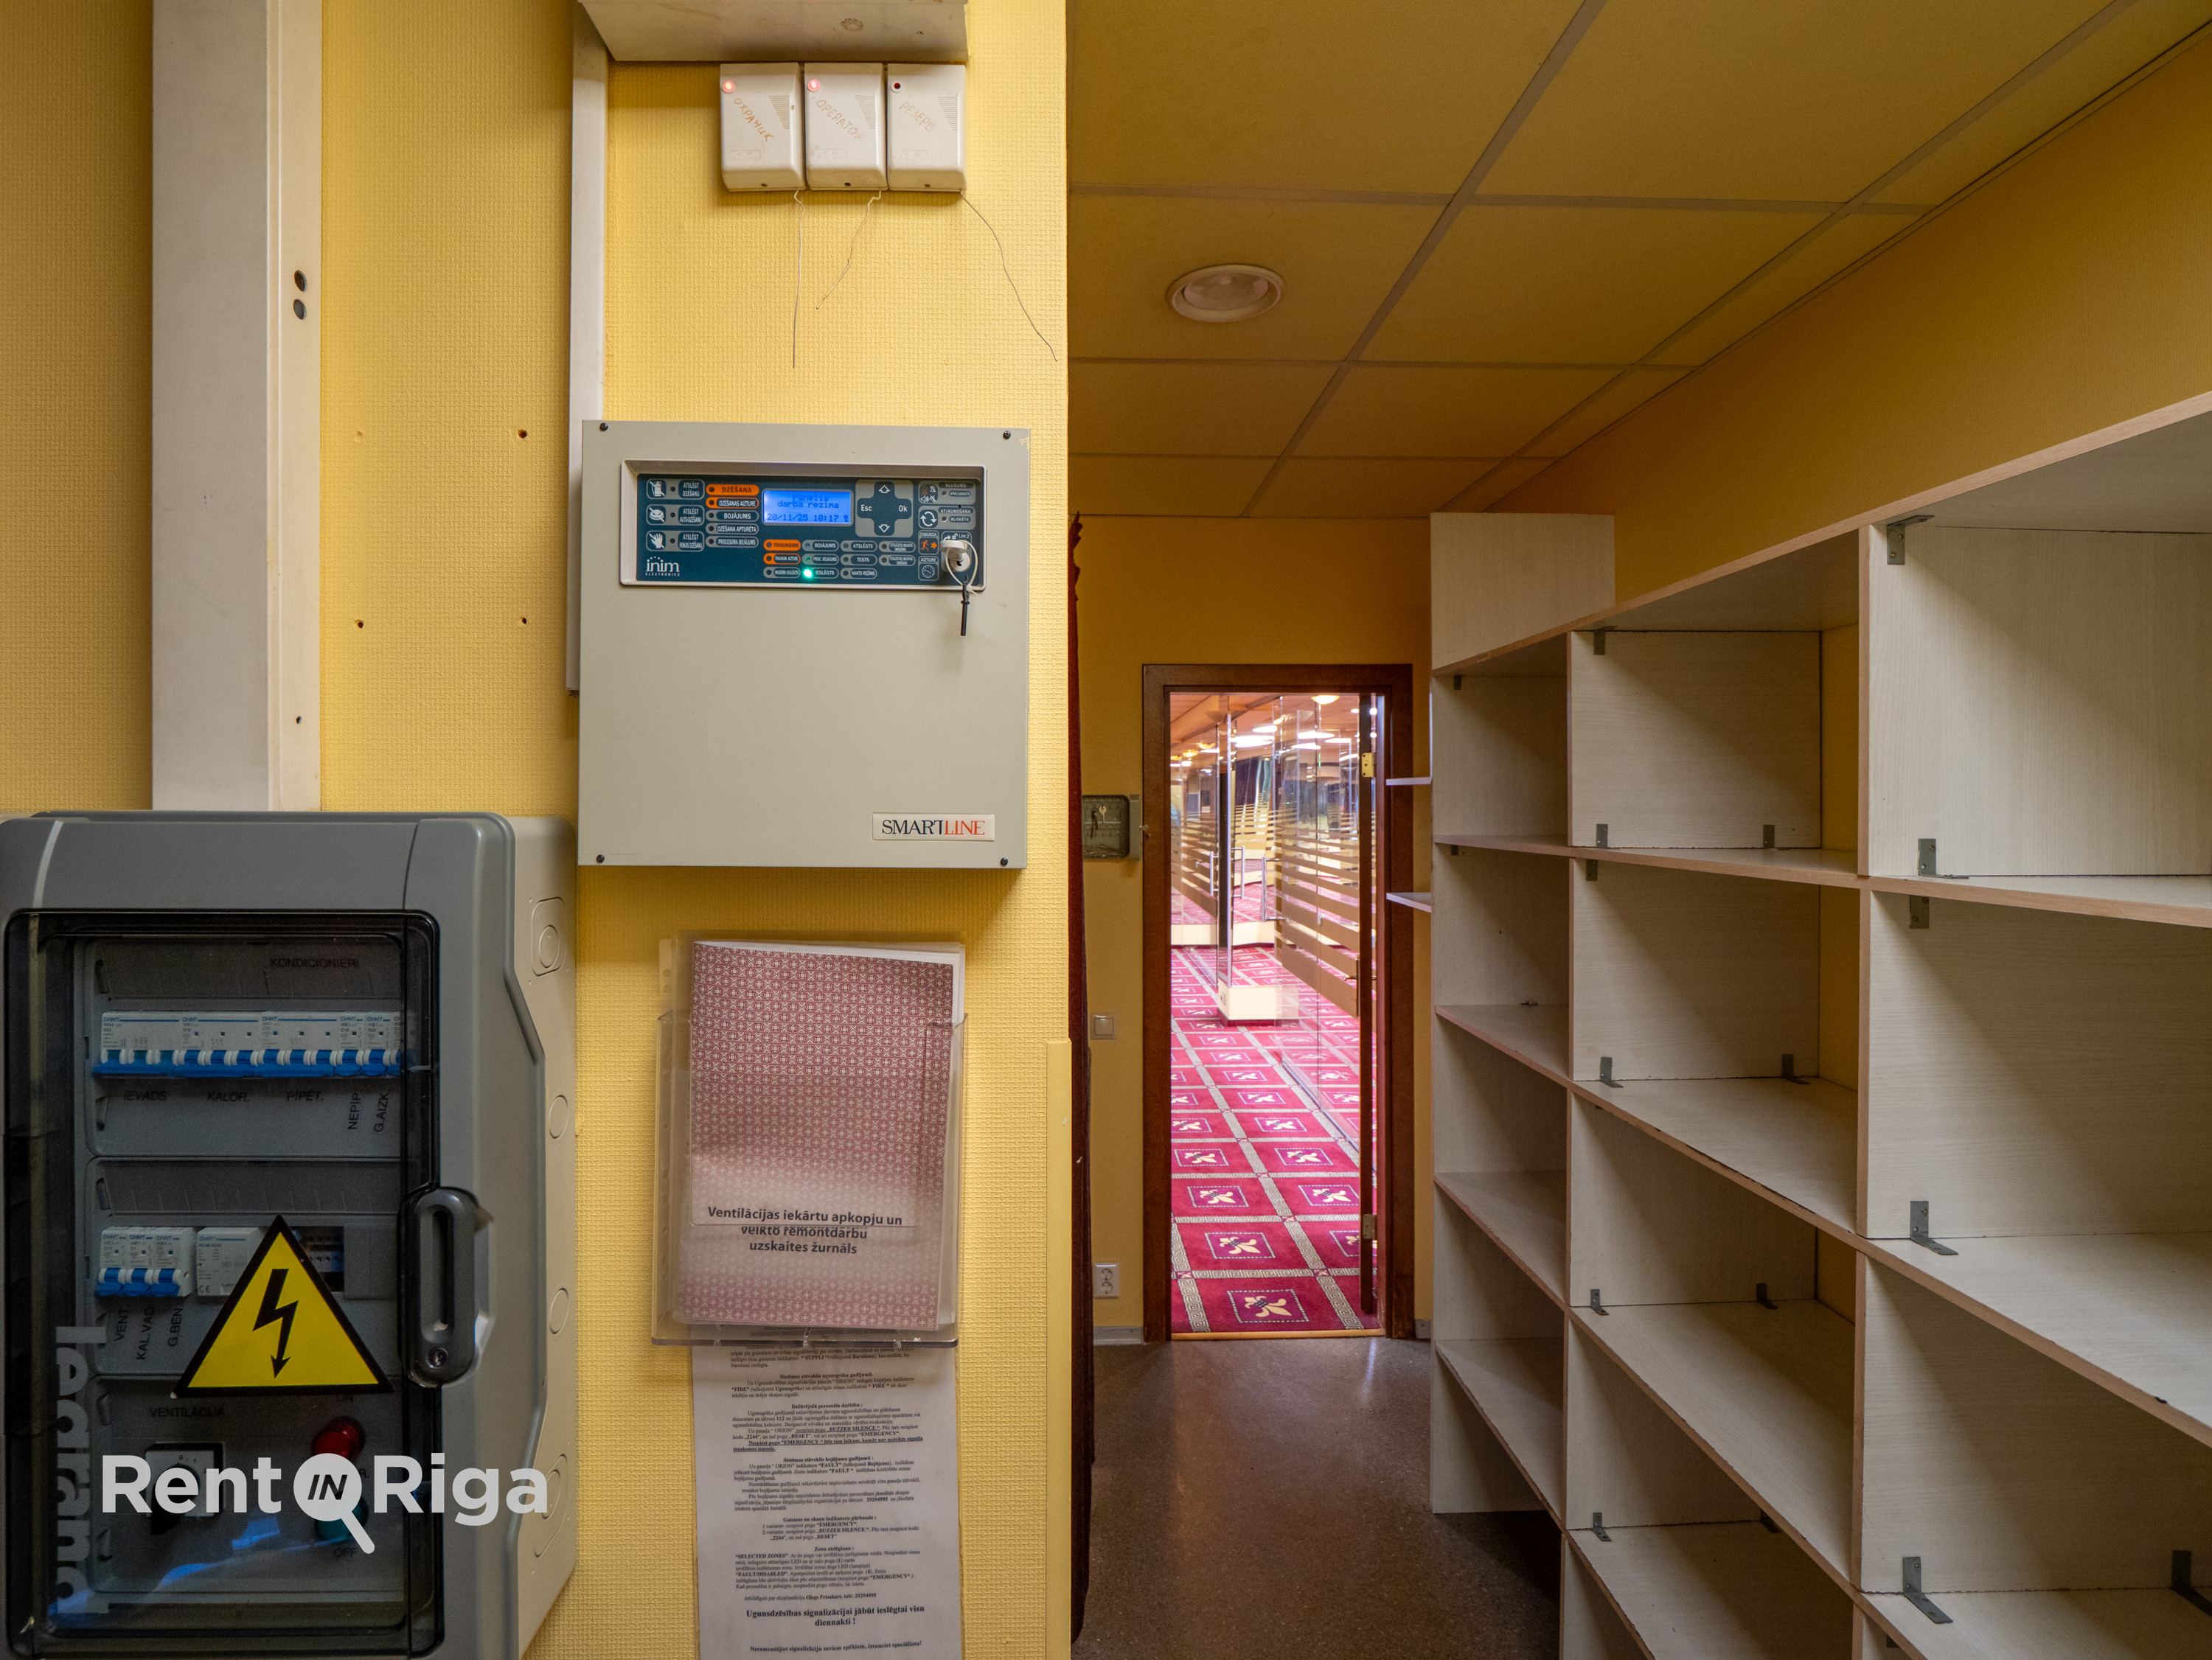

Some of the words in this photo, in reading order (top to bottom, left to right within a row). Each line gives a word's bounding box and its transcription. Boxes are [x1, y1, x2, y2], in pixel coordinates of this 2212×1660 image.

[646, 559, 680, 572] inim
[882, 820, 985, 835] SMARTLINE
[271, 958, 359, 969] KONDICIONIERI
[124, 1091, 167, 1101] IEVADS
[708, 1207, 780, 1221] Ventilācijas
[783, 1210, 828, 1221] iekārtu
[832, 1213, 883, 1225] apkopju
[749, 1241, 807, 1252] uzskaites
[811, 1242, 857, 1254] žurnāls
[746, 1609, 801, 1618] Ugunsdzēsības
[804, 1607, 852, 1617] signalizācijai
[855, 1607, 874, 1616] jābūt
[877, 1605, 908, 1614] ieslēgtai
[815, 1618, 851, 1626] diennakti
